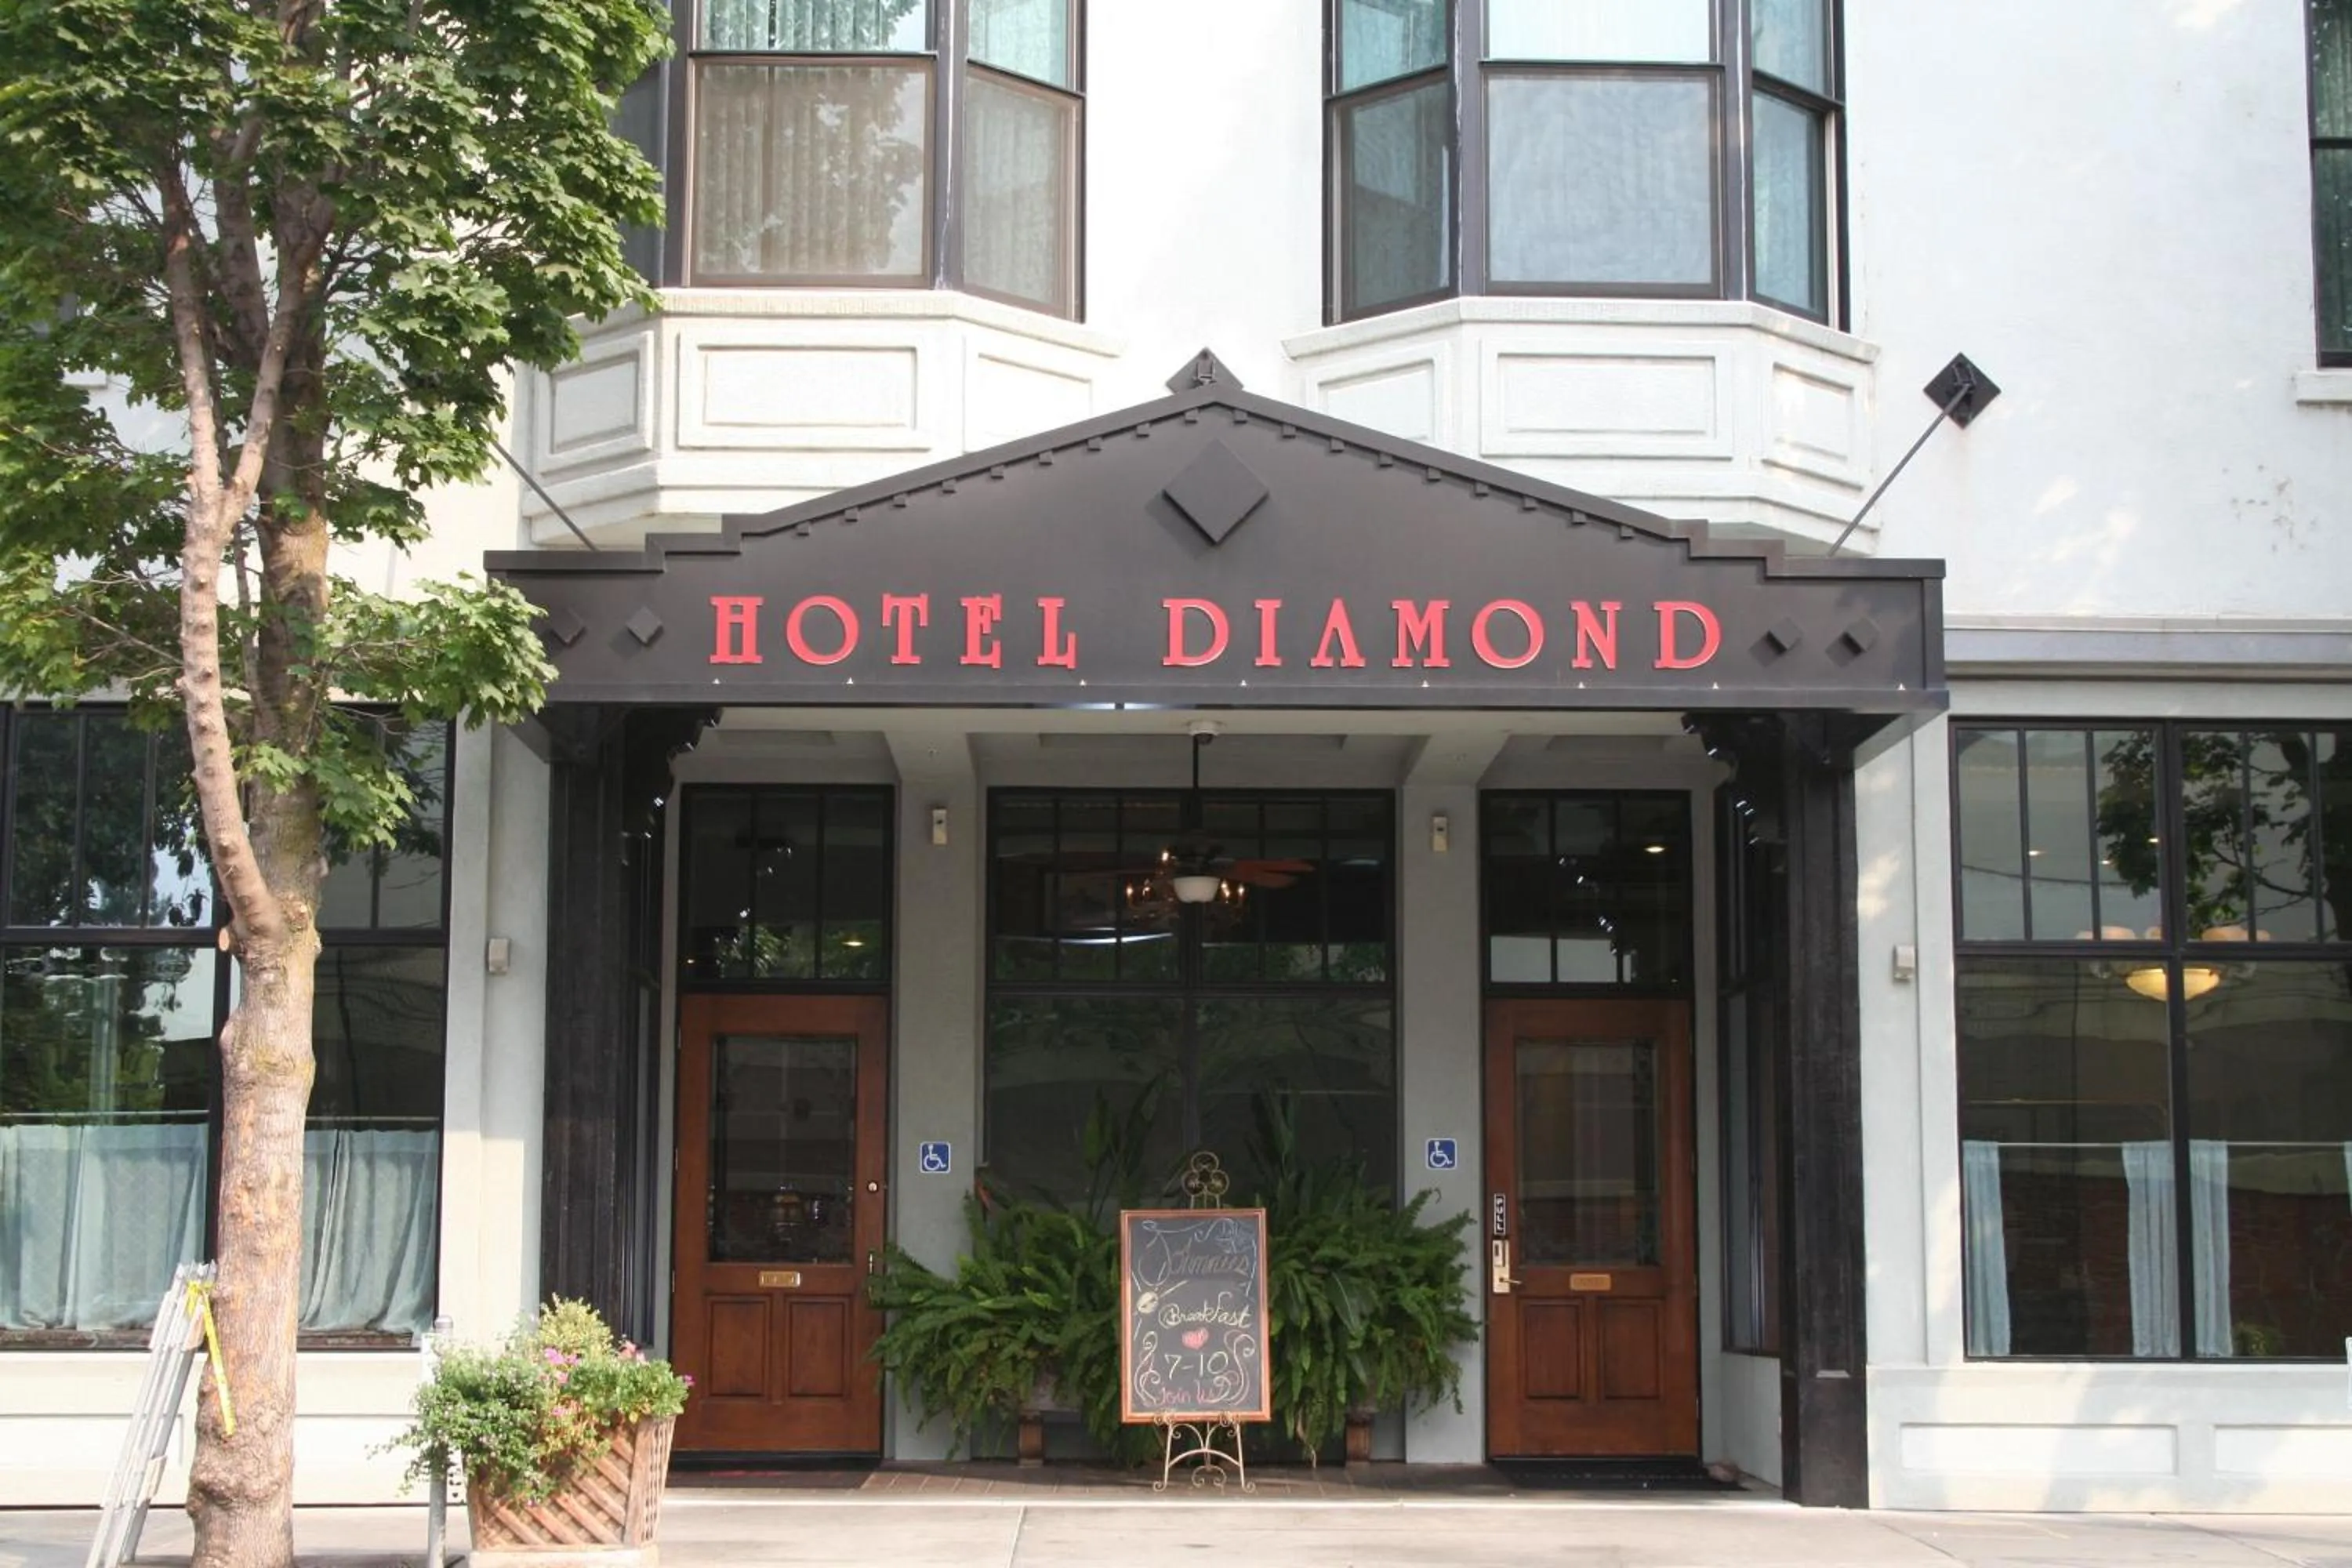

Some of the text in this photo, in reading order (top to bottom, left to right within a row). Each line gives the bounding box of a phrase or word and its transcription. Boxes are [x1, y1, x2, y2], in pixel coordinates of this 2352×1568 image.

[709, 593, 1722, 670] HOTEL DIAMOND
[1164, 1352, 1229, 1381] 7-10
